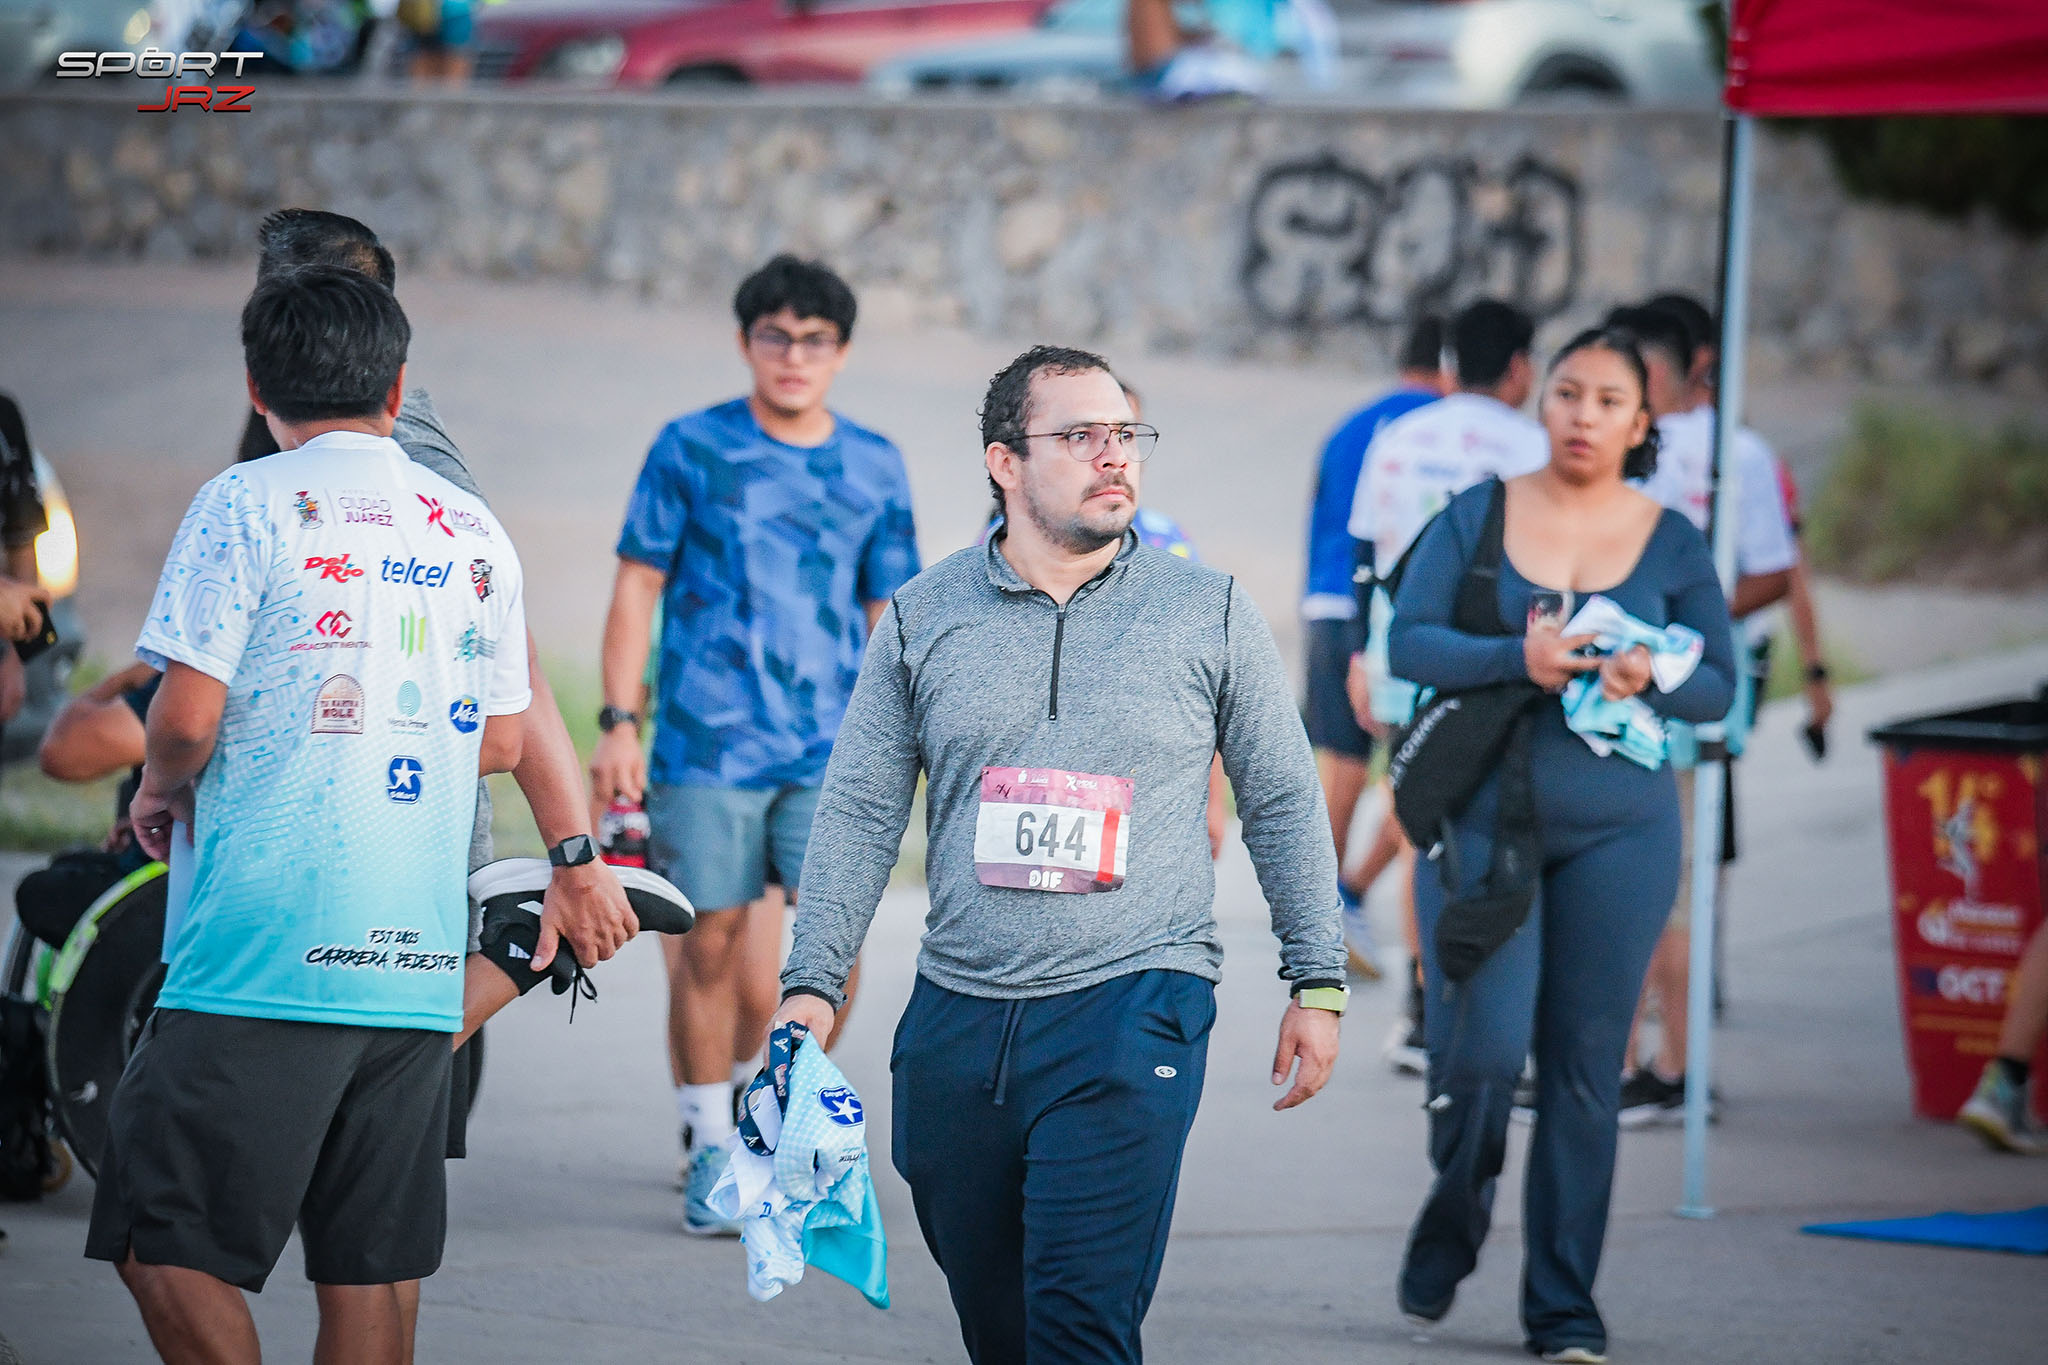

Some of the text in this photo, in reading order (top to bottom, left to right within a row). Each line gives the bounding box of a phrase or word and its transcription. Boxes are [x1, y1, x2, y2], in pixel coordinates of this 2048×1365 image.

[381, 555, 454, 587] telcel
[1016, 810, 1087, 861] 644
[1028, 869, 1065, 889] DIF
[305, 946, 390, 968] CARRERA
